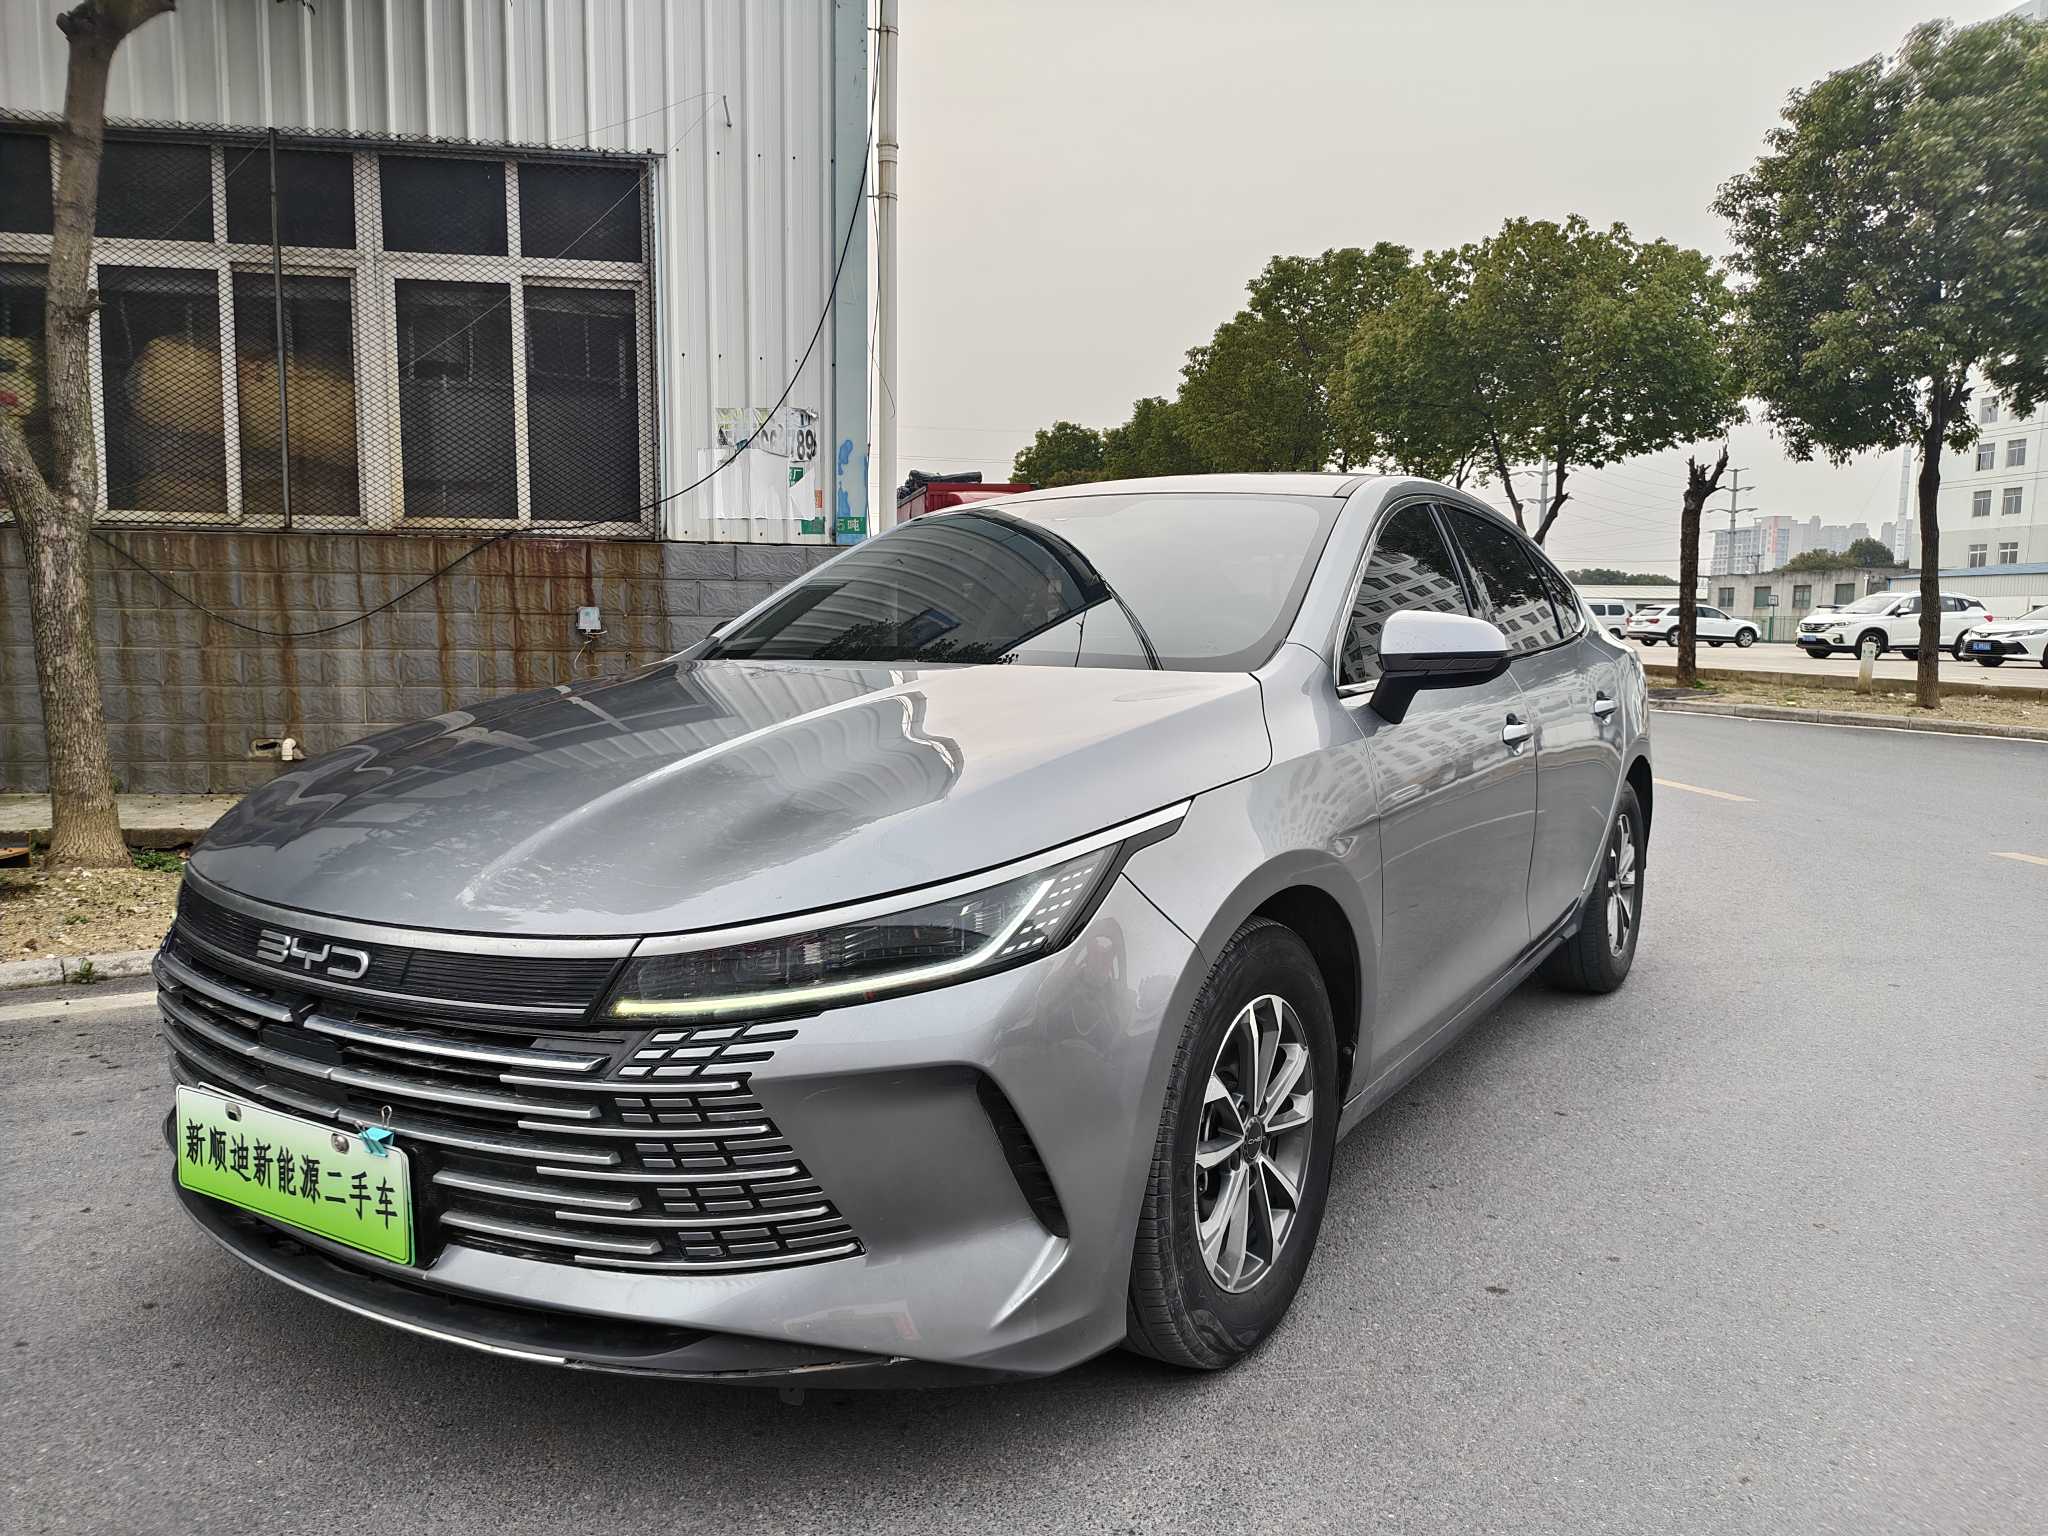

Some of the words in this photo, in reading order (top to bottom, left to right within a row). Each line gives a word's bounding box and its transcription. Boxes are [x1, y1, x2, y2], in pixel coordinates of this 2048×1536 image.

[256, 929, 369, 980] BYD
[185, 1118, 398, 1230] 新顺迪新能源二手车
